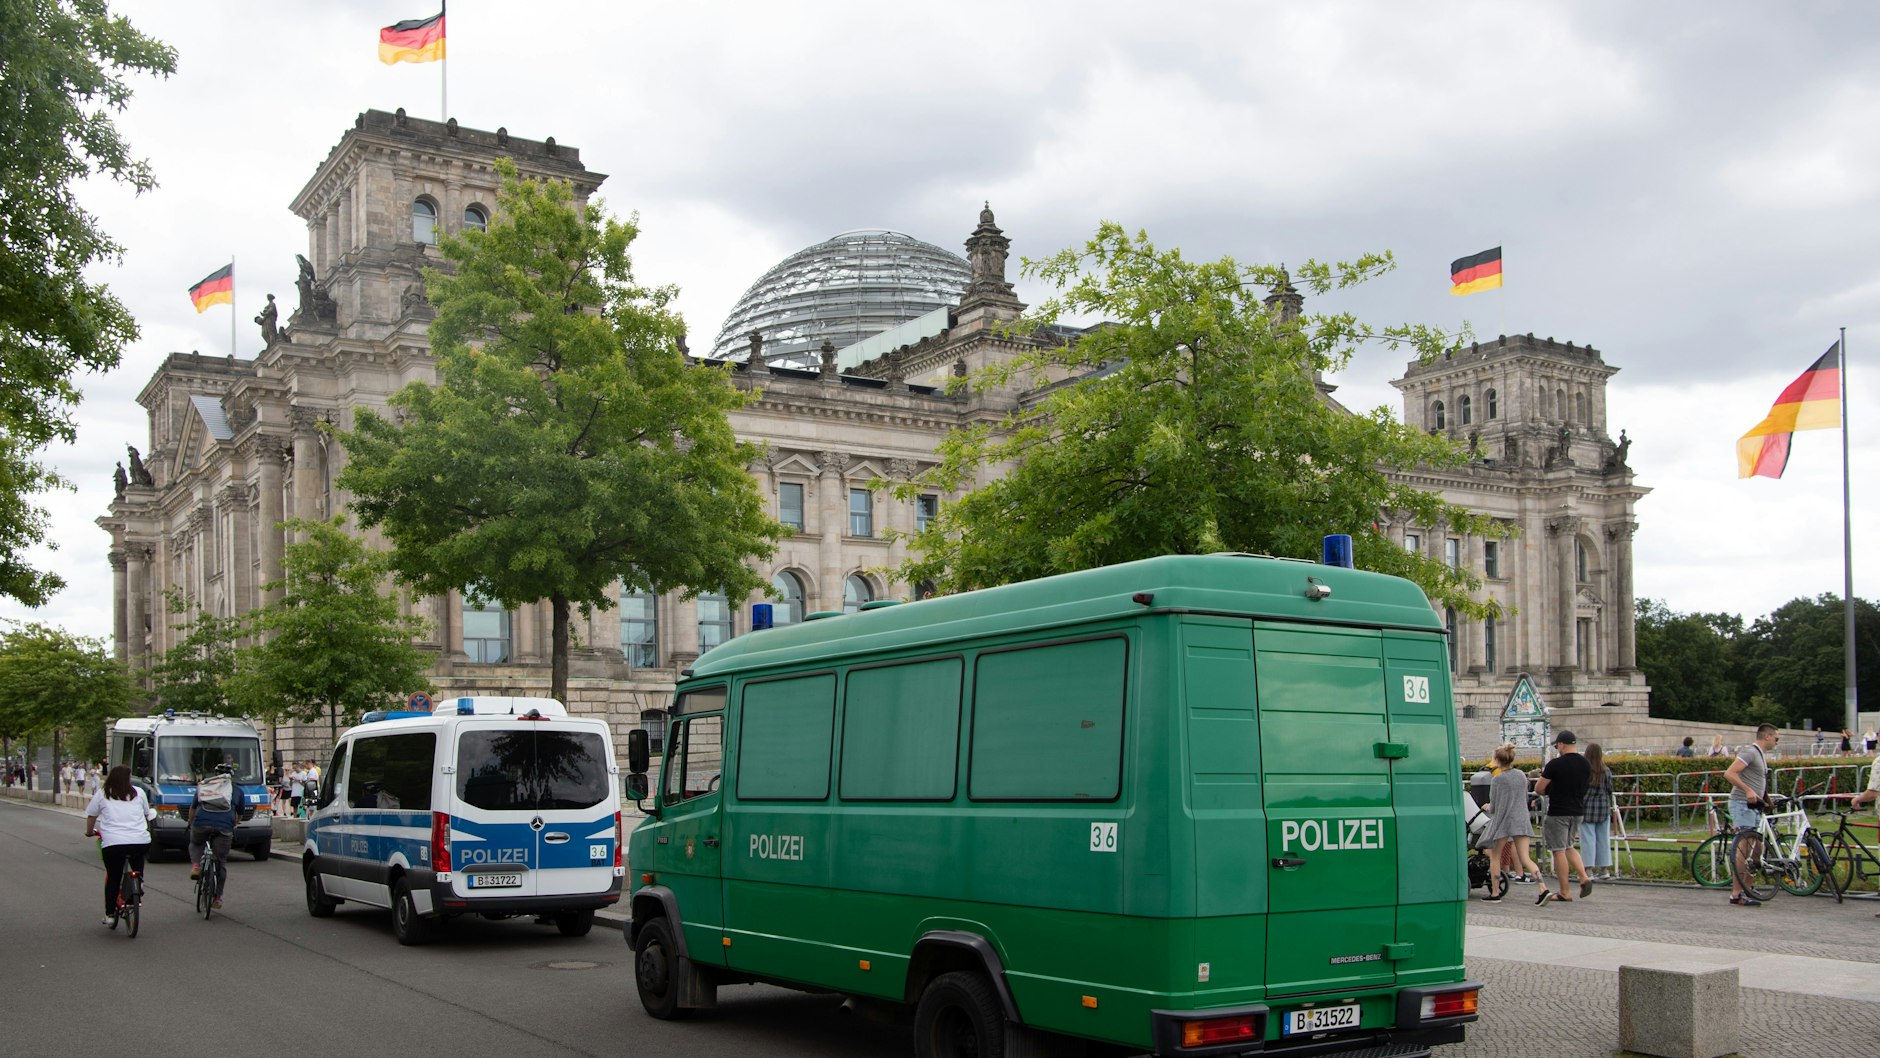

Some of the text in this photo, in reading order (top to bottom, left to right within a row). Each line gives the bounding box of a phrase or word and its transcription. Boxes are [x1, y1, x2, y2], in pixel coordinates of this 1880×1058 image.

[1406, 679, 1427, 700] 36
[1092, 826, 1115, 849] 36
[1281, 819, 1384, 852] POLIZEI
[351, 840, 369, 854] POLIZEI
[461, 848, 529, 864] POLIZEI
[591, 846, 606, 858] 36
[750, 834, 804, 861] POLIZEI
[478, 875, 517, 886] B 31722
[1330, 953, 1382, 965] MERCEDES-BENZ
[1297, 1008, 1353, 1031] B 31522
